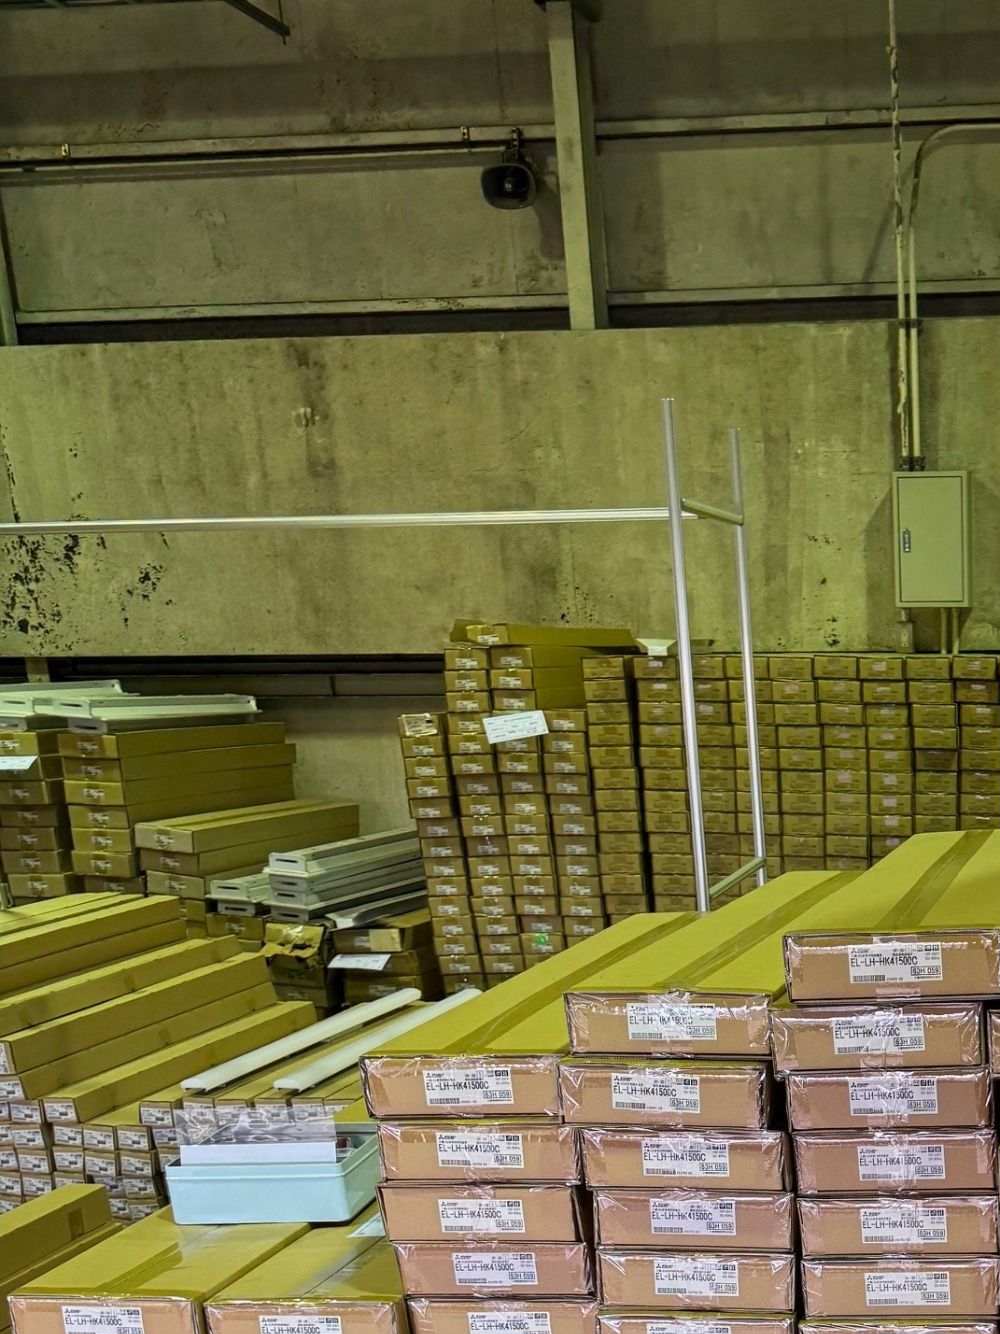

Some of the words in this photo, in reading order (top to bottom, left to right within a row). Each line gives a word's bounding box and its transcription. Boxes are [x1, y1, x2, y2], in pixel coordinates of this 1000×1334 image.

[850, 956, 918, 967] EL-LH-HK41500C
[425, 1080, 490, 1091] EL-LH-HK41500C
[437, 1143, 501, 1153] EL-LH-HK41500C
[643, 1152, 707, 1162] EL-LH-HK41500C
[440, 1210, 502, 1219] EL-LH-HK41500C
[651, 1210, 713, 1221] EL-LH-HK41500C
[861, 1219, 924, 1229] EL-LH-HK41500C
[454, 1263, 515, 1271] EL-LH-HK41500C
[866, 1283, 928, 1292] EL-LH-HK41500C
